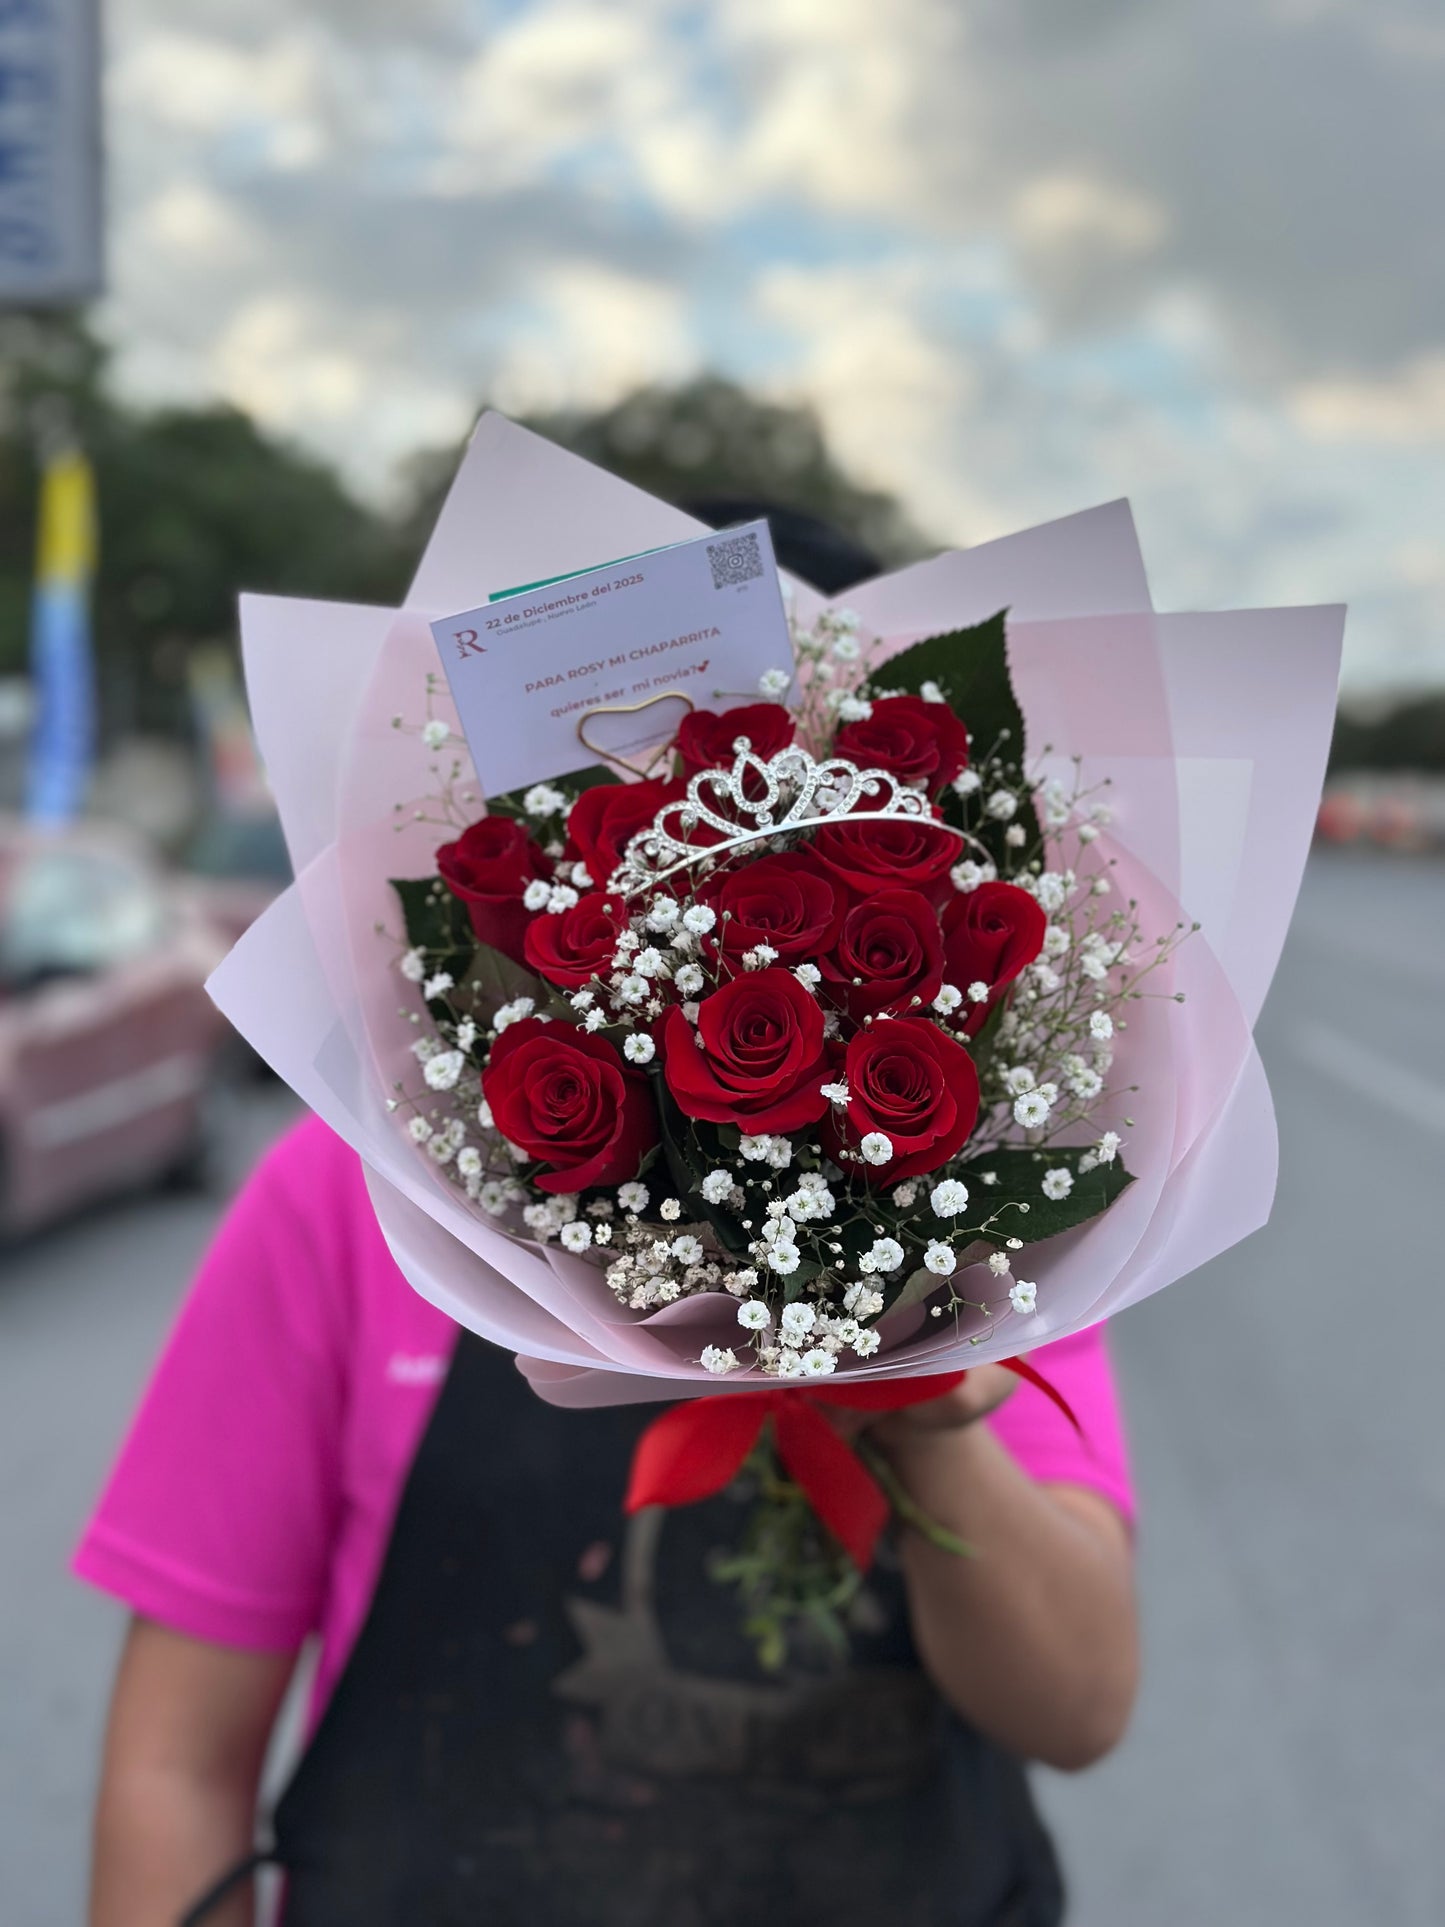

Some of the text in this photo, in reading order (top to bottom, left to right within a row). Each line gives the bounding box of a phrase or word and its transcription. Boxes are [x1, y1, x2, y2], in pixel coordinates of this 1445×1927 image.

[485, 573, 644, 630] 22 de Diciembre del 2025
[547, 607, 575, 621] Nuevo
[525, 626, 721, 693] PARA ROSY MI CHAPARRITA
[550, 664, 697, 718] quieres ser mi novia?
